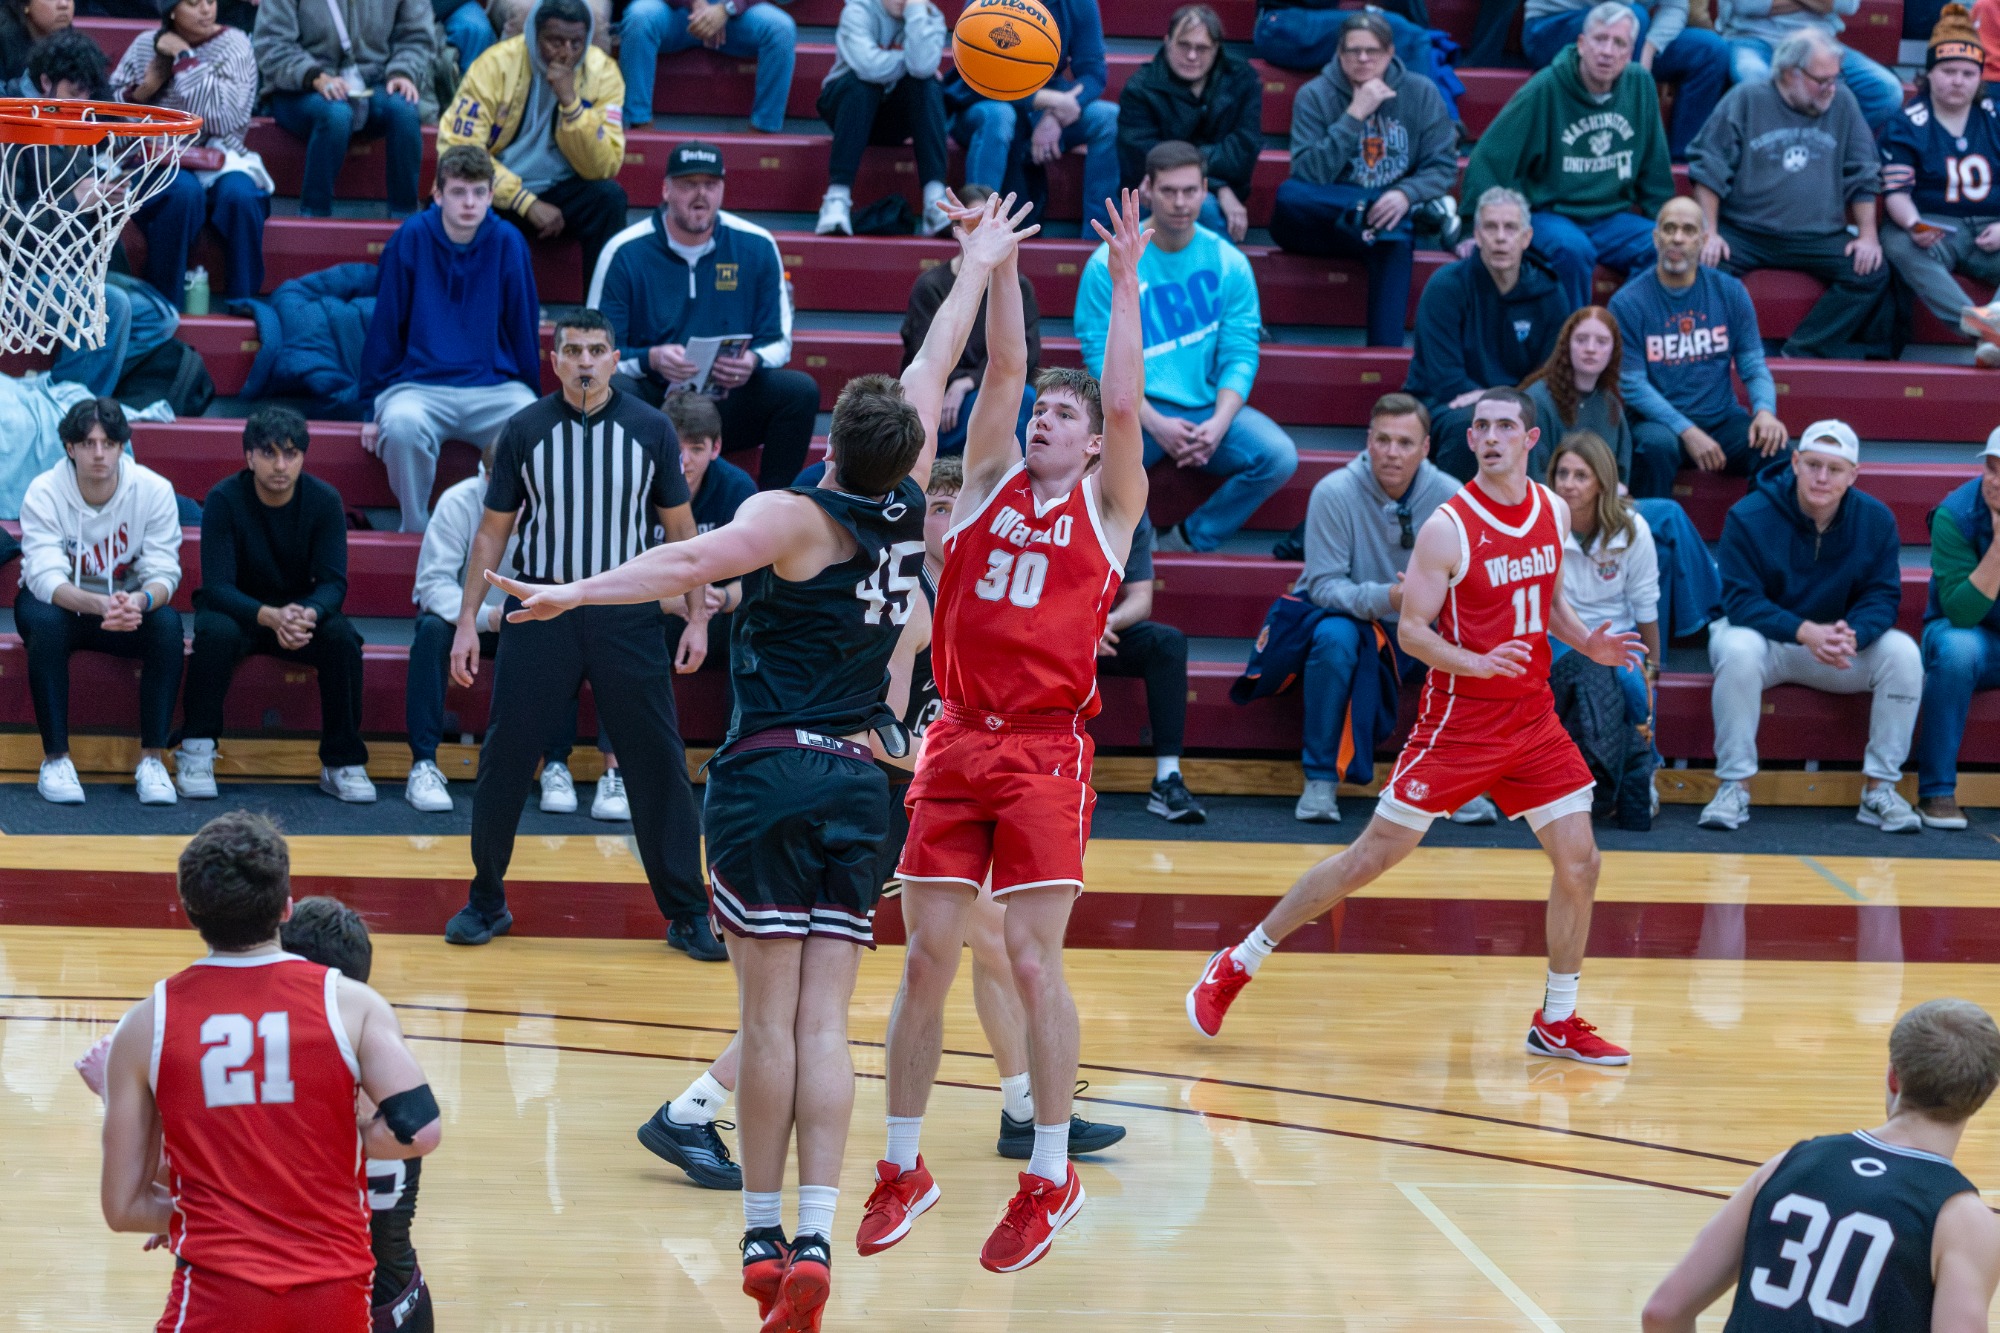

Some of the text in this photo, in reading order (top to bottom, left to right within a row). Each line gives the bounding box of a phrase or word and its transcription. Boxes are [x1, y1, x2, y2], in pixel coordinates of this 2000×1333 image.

[452, 117, 475, 138] 05
[1561, 111, 1635, 147] WASHINGTON
[1945, 154, 1993, 203] 10
[1645, 325, 1730, 363] BEARS
[69, 522, 129, 576] EARS
[1484, 544, 1557, 588] WashU
[856, 540, 927, 626] 45
[975, 548, 1050, 609] 30
[1511, 583, 1544, 638] 11
[199, 1010, 296, 1109] 21
[1750, 1193, 1896, 1328] 30
